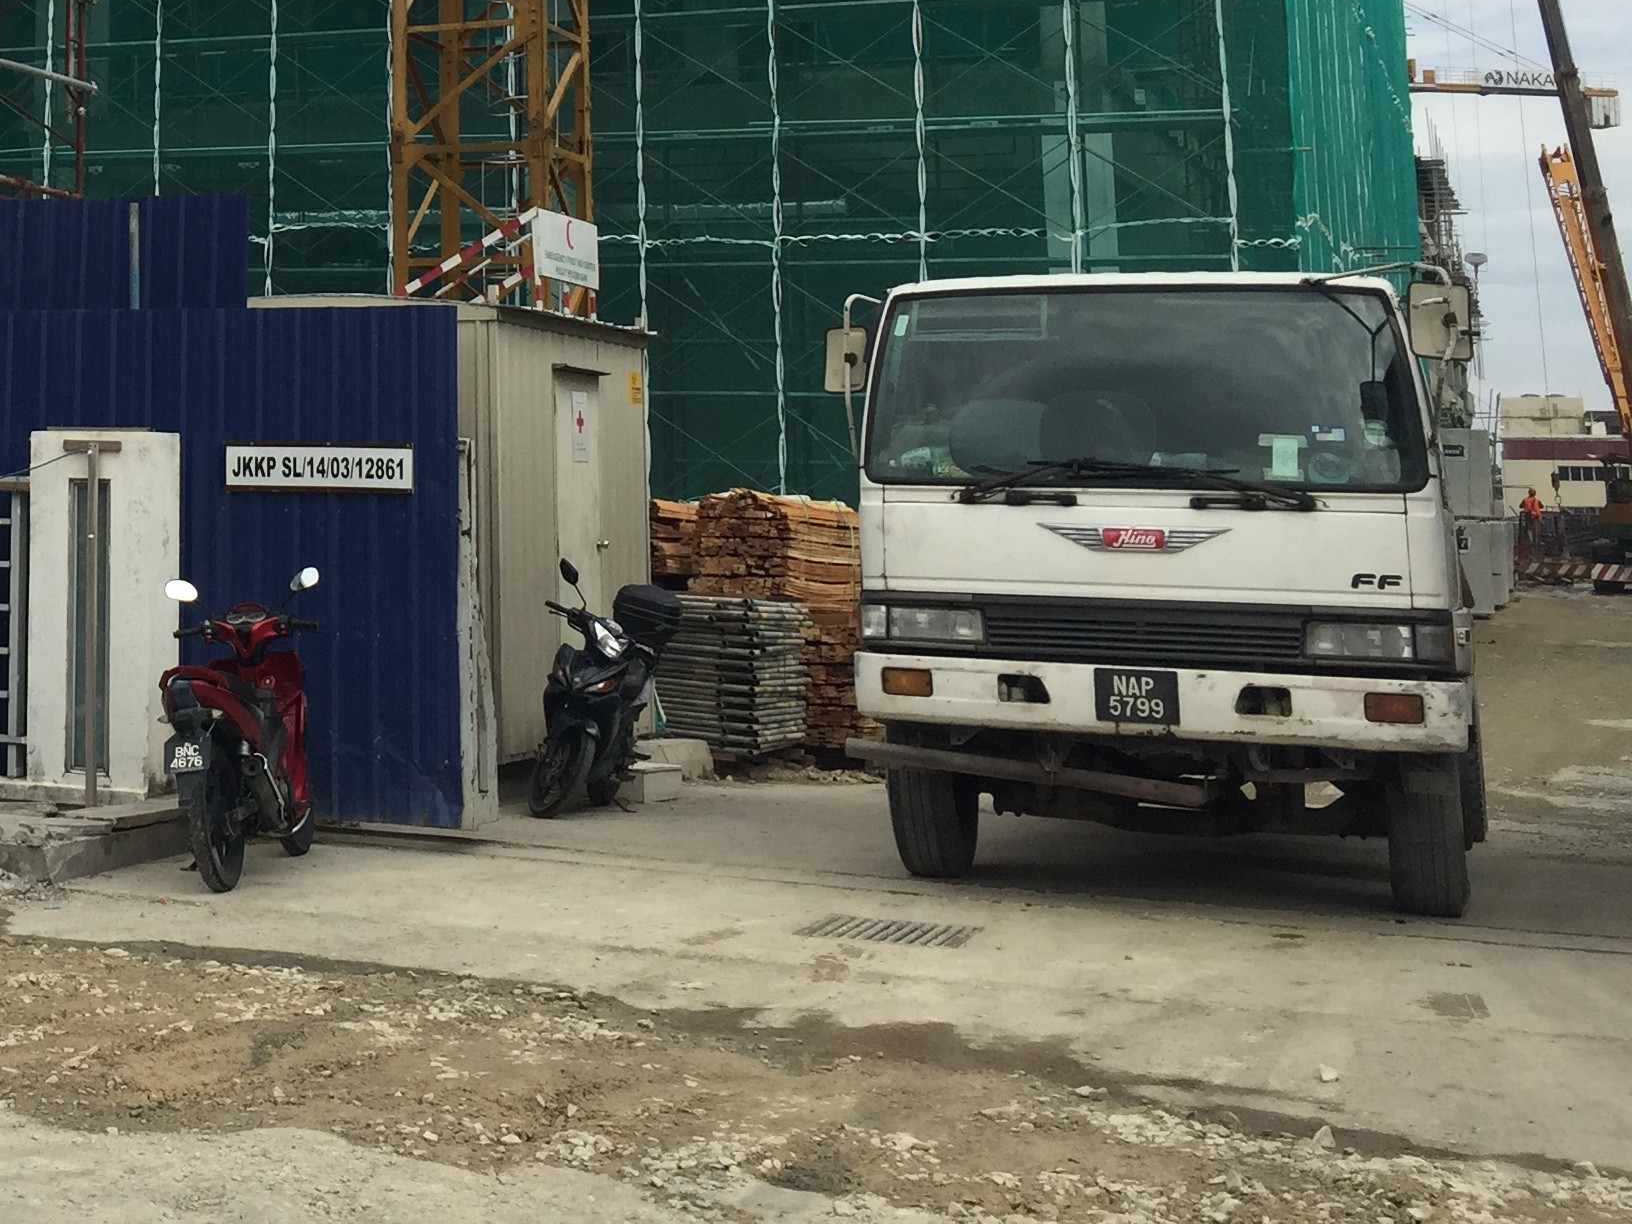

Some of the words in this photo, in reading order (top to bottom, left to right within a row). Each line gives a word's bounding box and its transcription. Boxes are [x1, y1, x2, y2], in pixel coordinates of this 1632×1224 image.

[1506, 71, 1556, 87] NAKA
[232, 456, 276, 478] JKKP
[281, 456, 404, 480] SL/14/03/12861
[1113, 529, 1156, 547] Hino
[1351, 573, 1403, 590] FF
[1113, 675, 1154, 696] NAP
[1109, 696, 1164, 718] 5799
[175, 744, 199, 757] BNC
[170, 756, 203, 768] 4676
